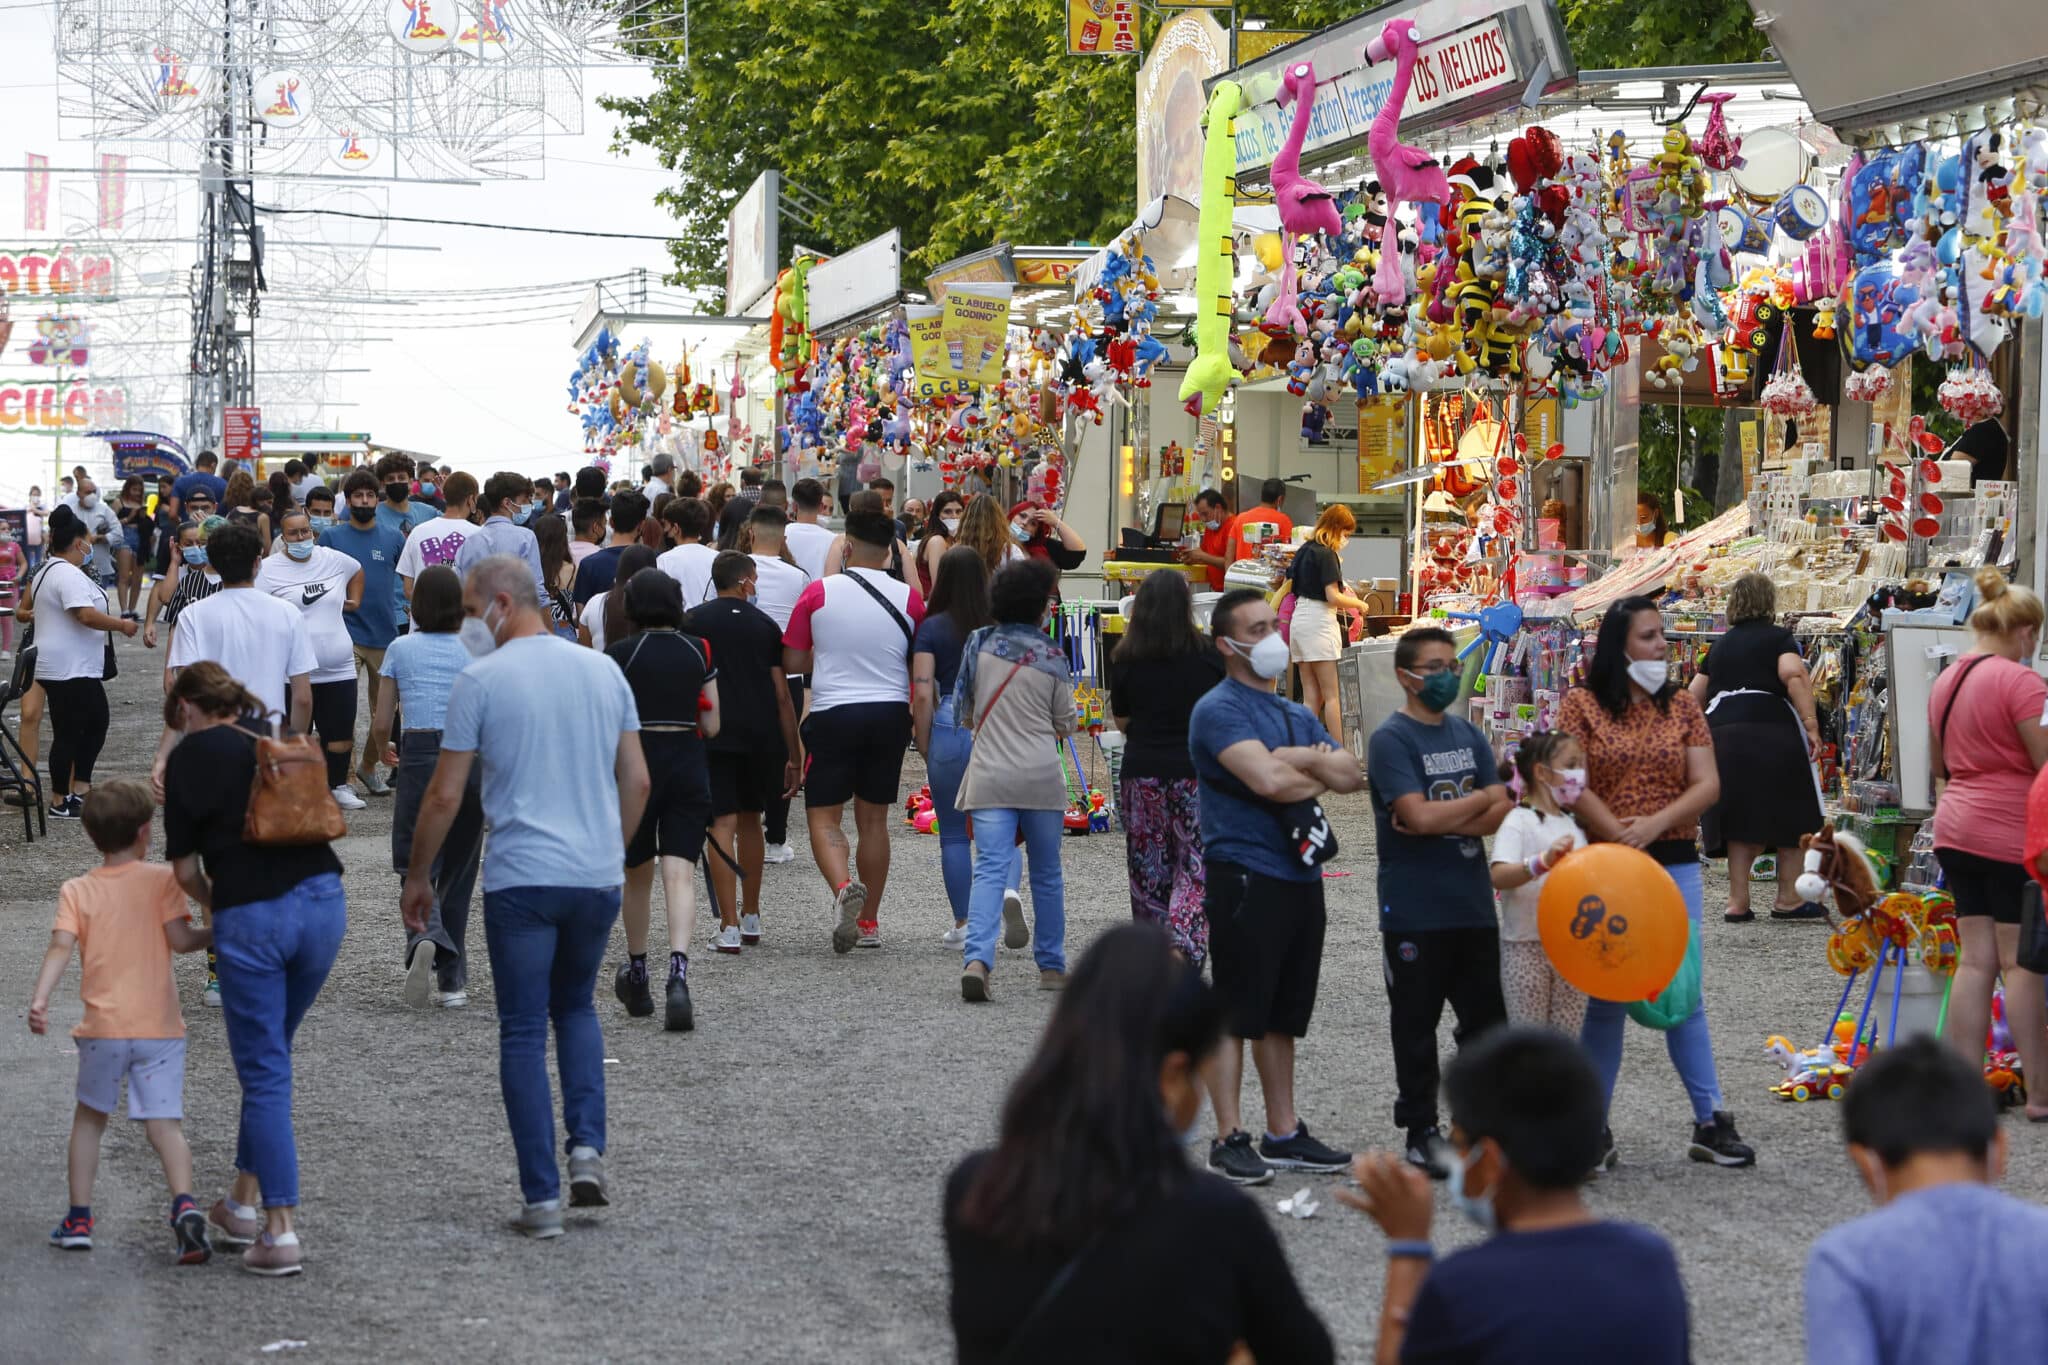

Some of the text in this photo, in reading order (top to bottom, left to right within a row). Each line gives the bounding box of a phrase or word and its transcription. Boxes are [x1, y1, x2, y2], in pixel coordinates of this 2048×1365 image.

[1413, 56, 1439, 102] LOS
[1262, 117, 1280, 154] de
[966, 298, 1005, 312] ABUELO
[304, 583, 326, 594] NIKE
